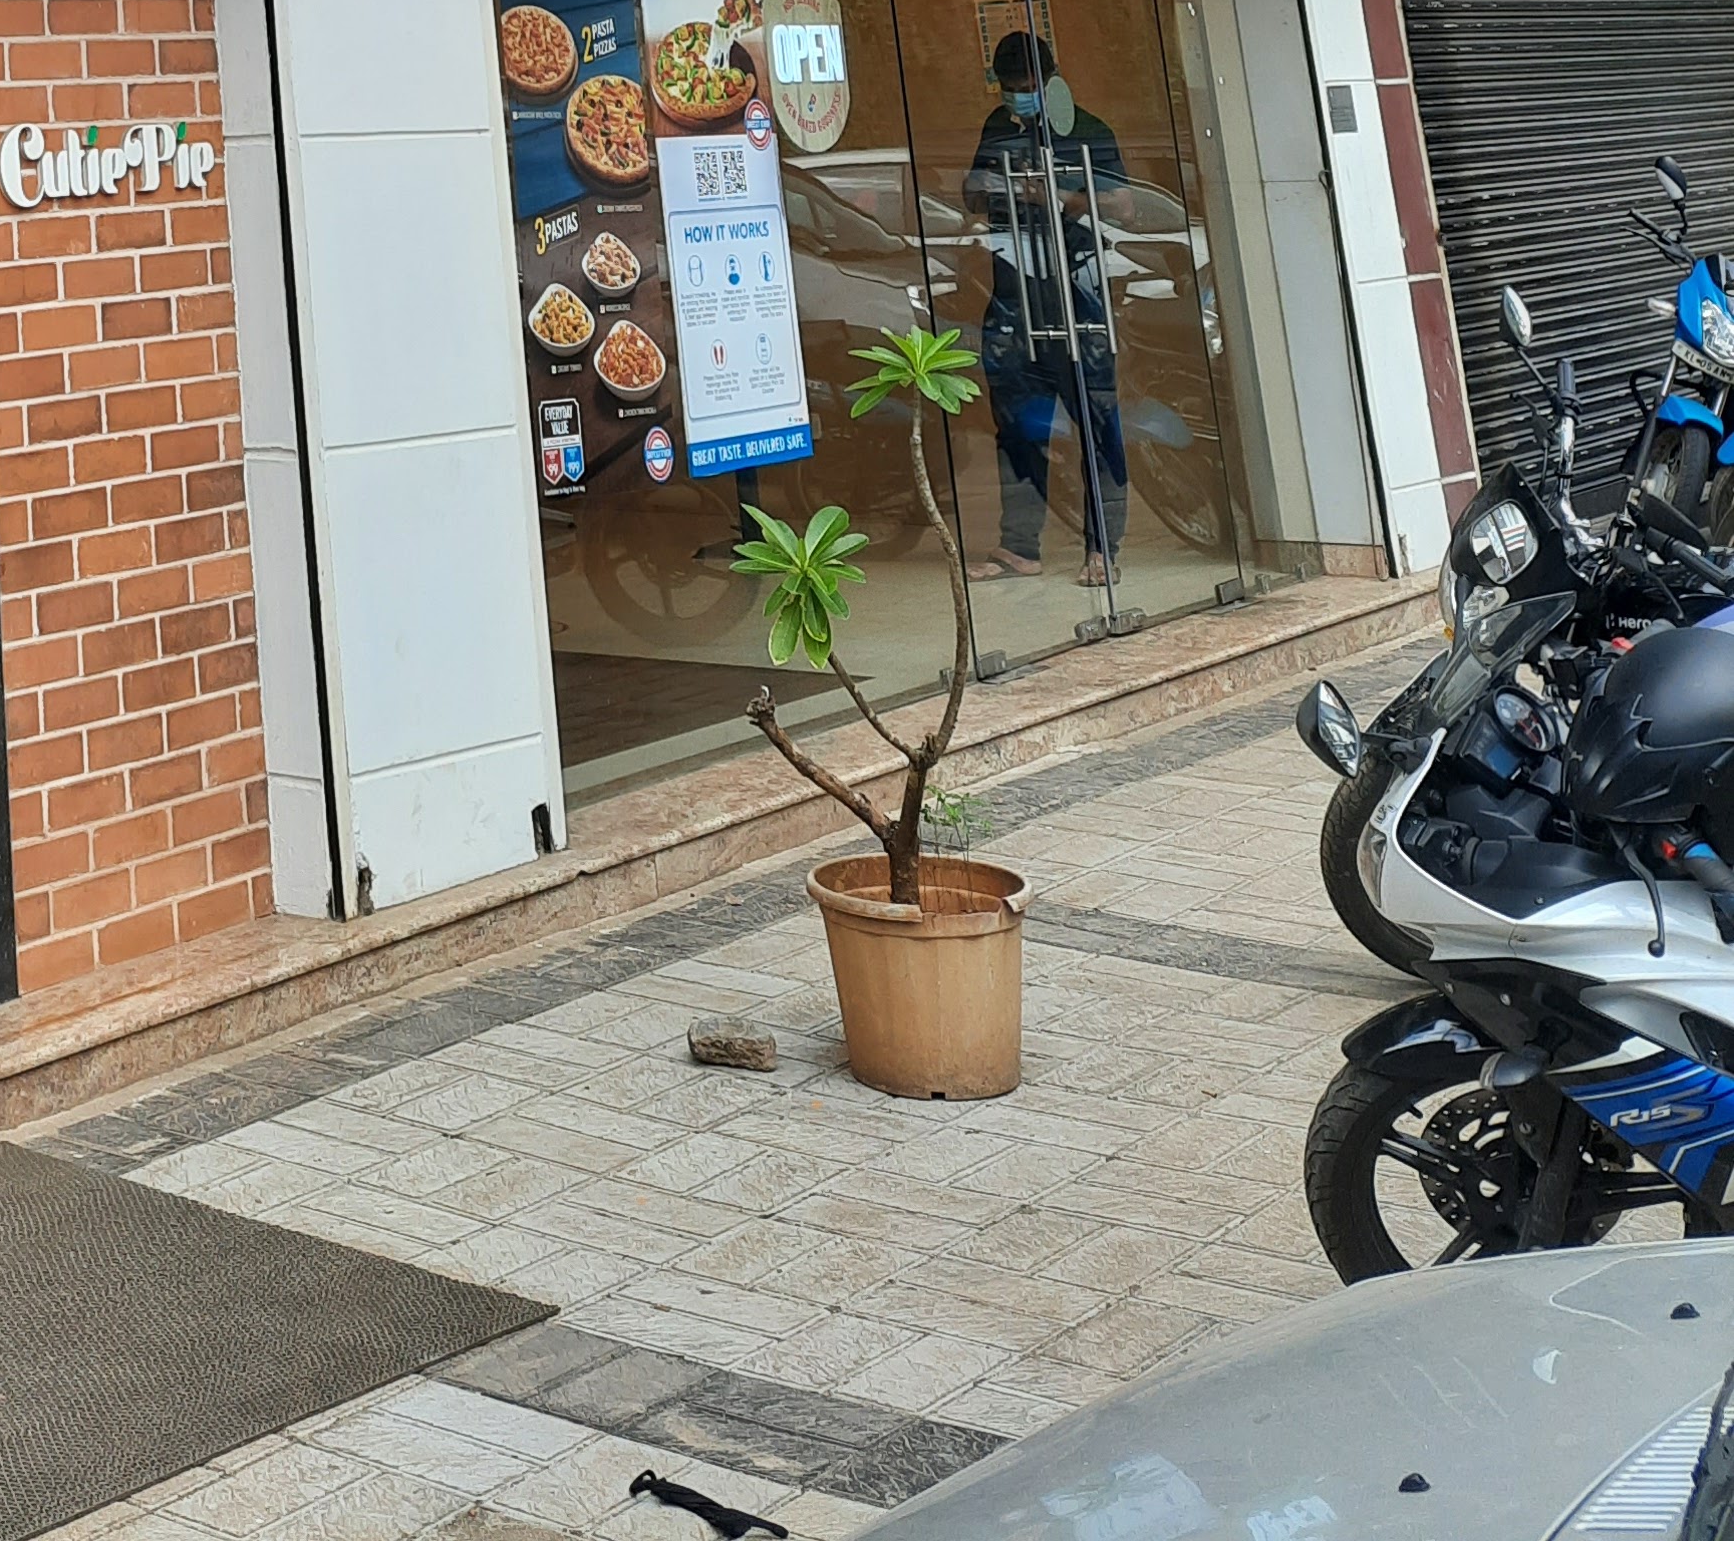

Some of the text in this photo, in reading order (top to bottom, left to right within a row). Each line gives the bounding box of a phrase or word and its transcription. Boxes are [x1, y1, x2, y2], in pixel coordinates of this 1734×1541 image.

[581, 18, 615, 64] 2 PASTA
[772, 23, 845, 84] OPEN
[534, 211, 579, 256] 3 PASTAS
[684, 220, 770, 244] HOW IT WORKS
[692, 447, 716, 467] GREAT
[746, 436, 785, 458] DELIVERED
[1618, 616, 1652, 630] Hero
